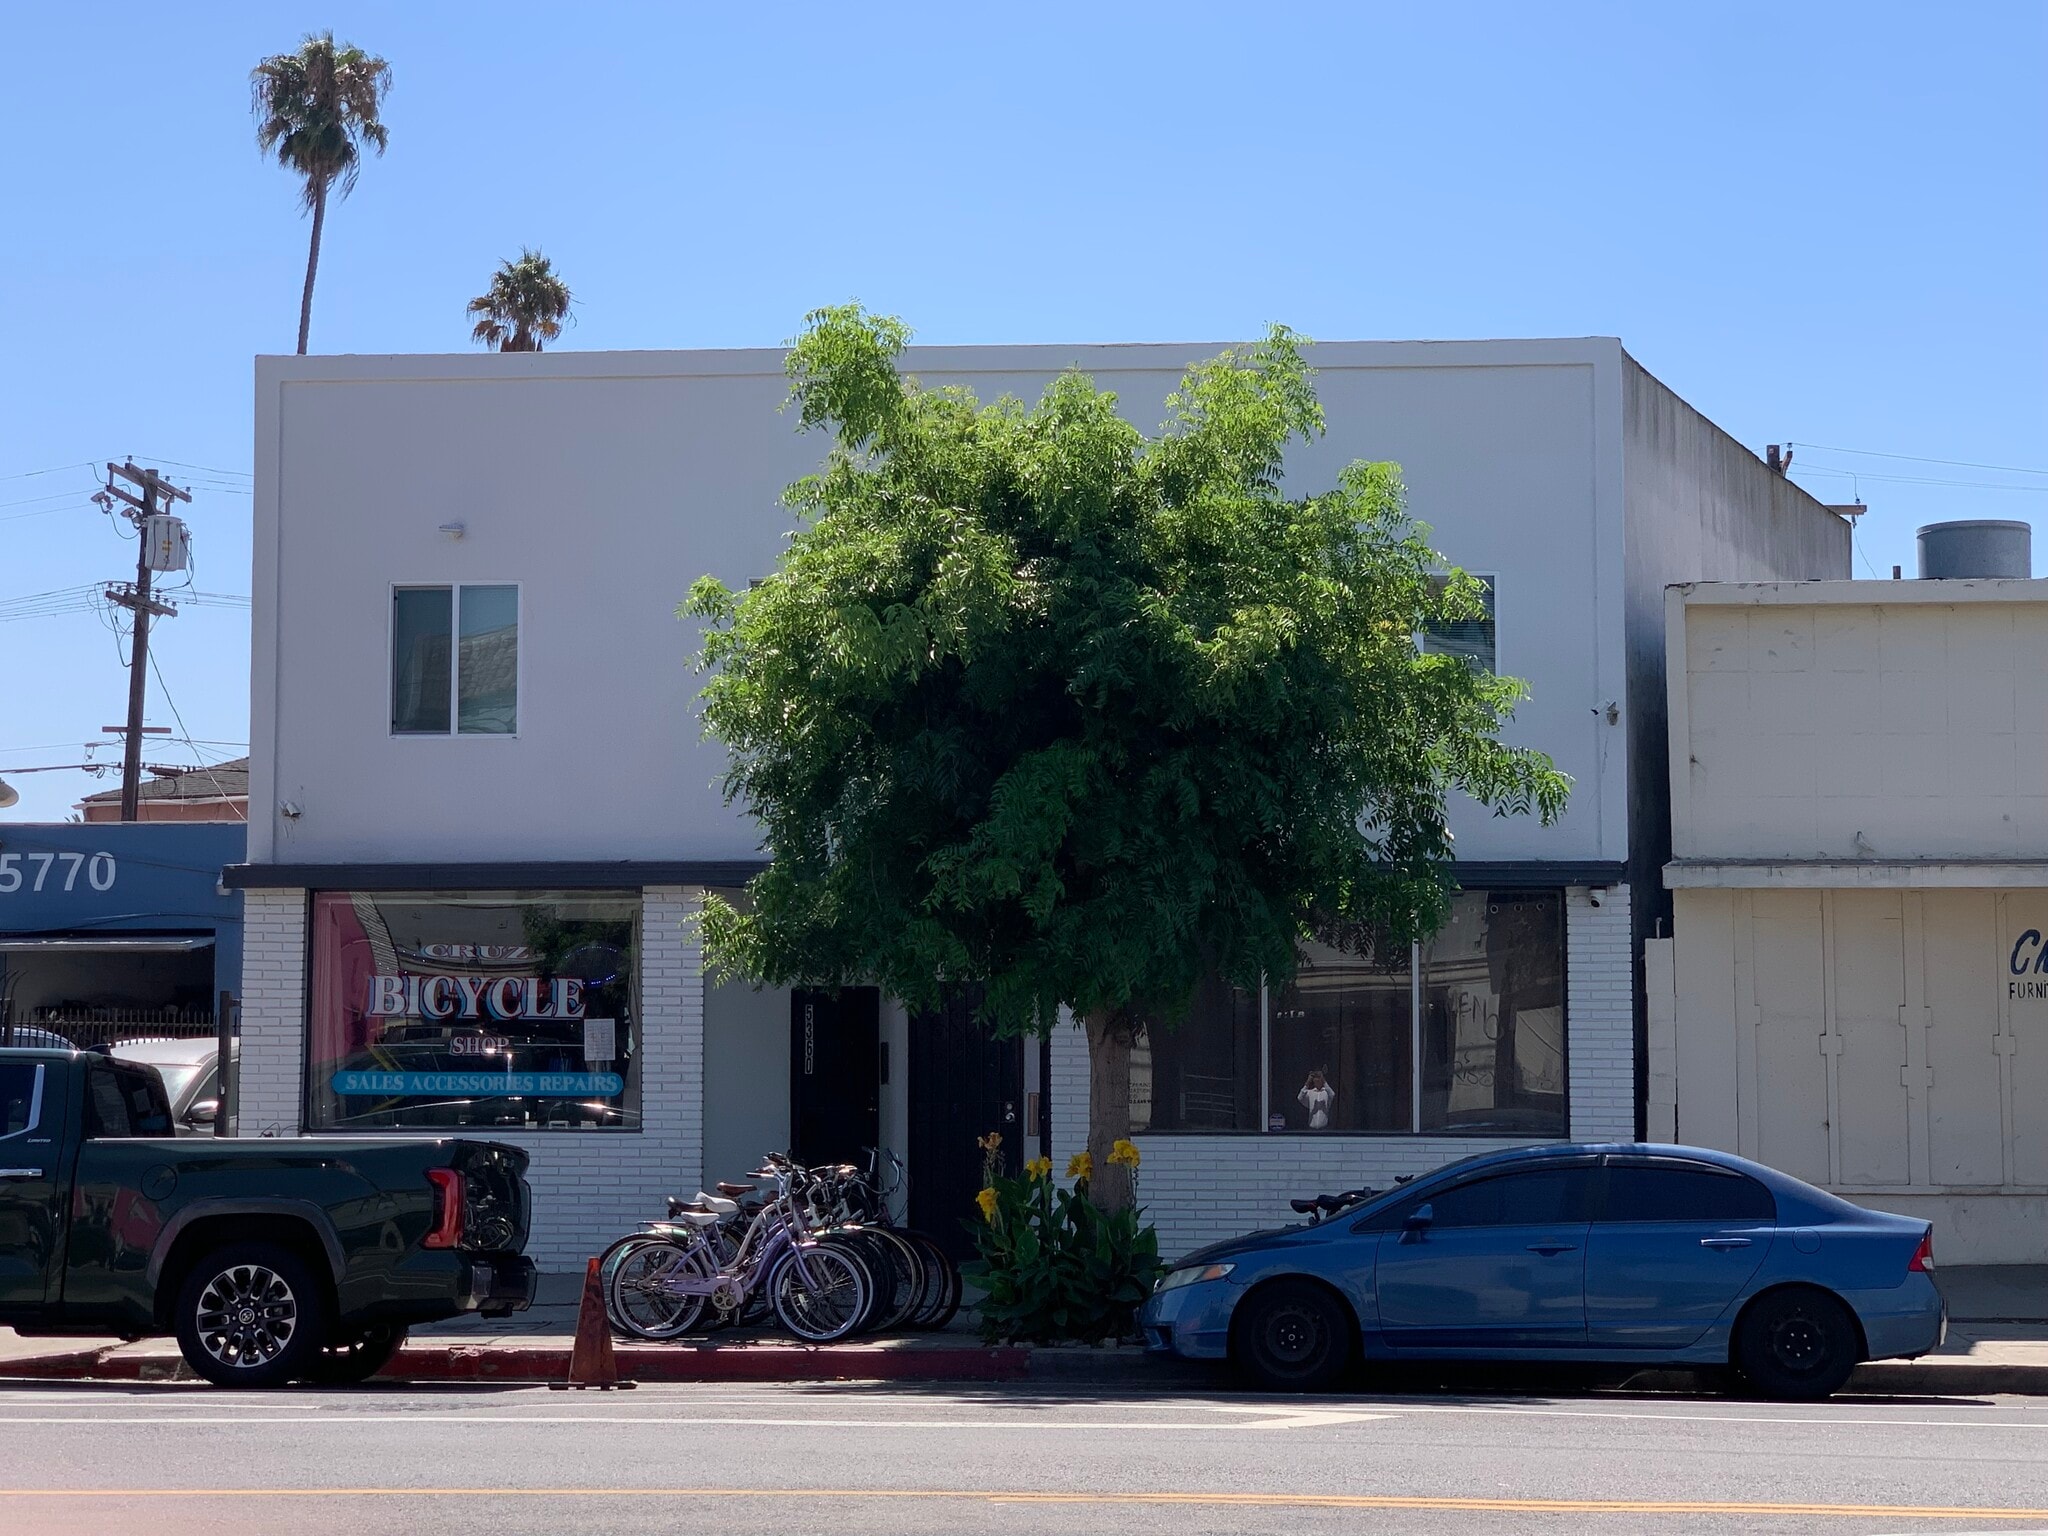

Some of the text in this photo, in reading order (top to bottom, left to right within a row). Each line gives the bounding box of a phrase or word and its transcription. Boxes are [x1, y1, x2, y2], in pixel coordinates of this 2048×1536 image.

[0, 851, 116, 893] 5770
[421, 943, 530, 960] CRUZ
[367, 975, 587, 1020] BICYCLE
[449, 1035, 511, 1057] SHOP
[805, 1004, 814, 1074] 5360
[345, 1074, 618, 1092] SALES ACCESSORIES REPAIRS
